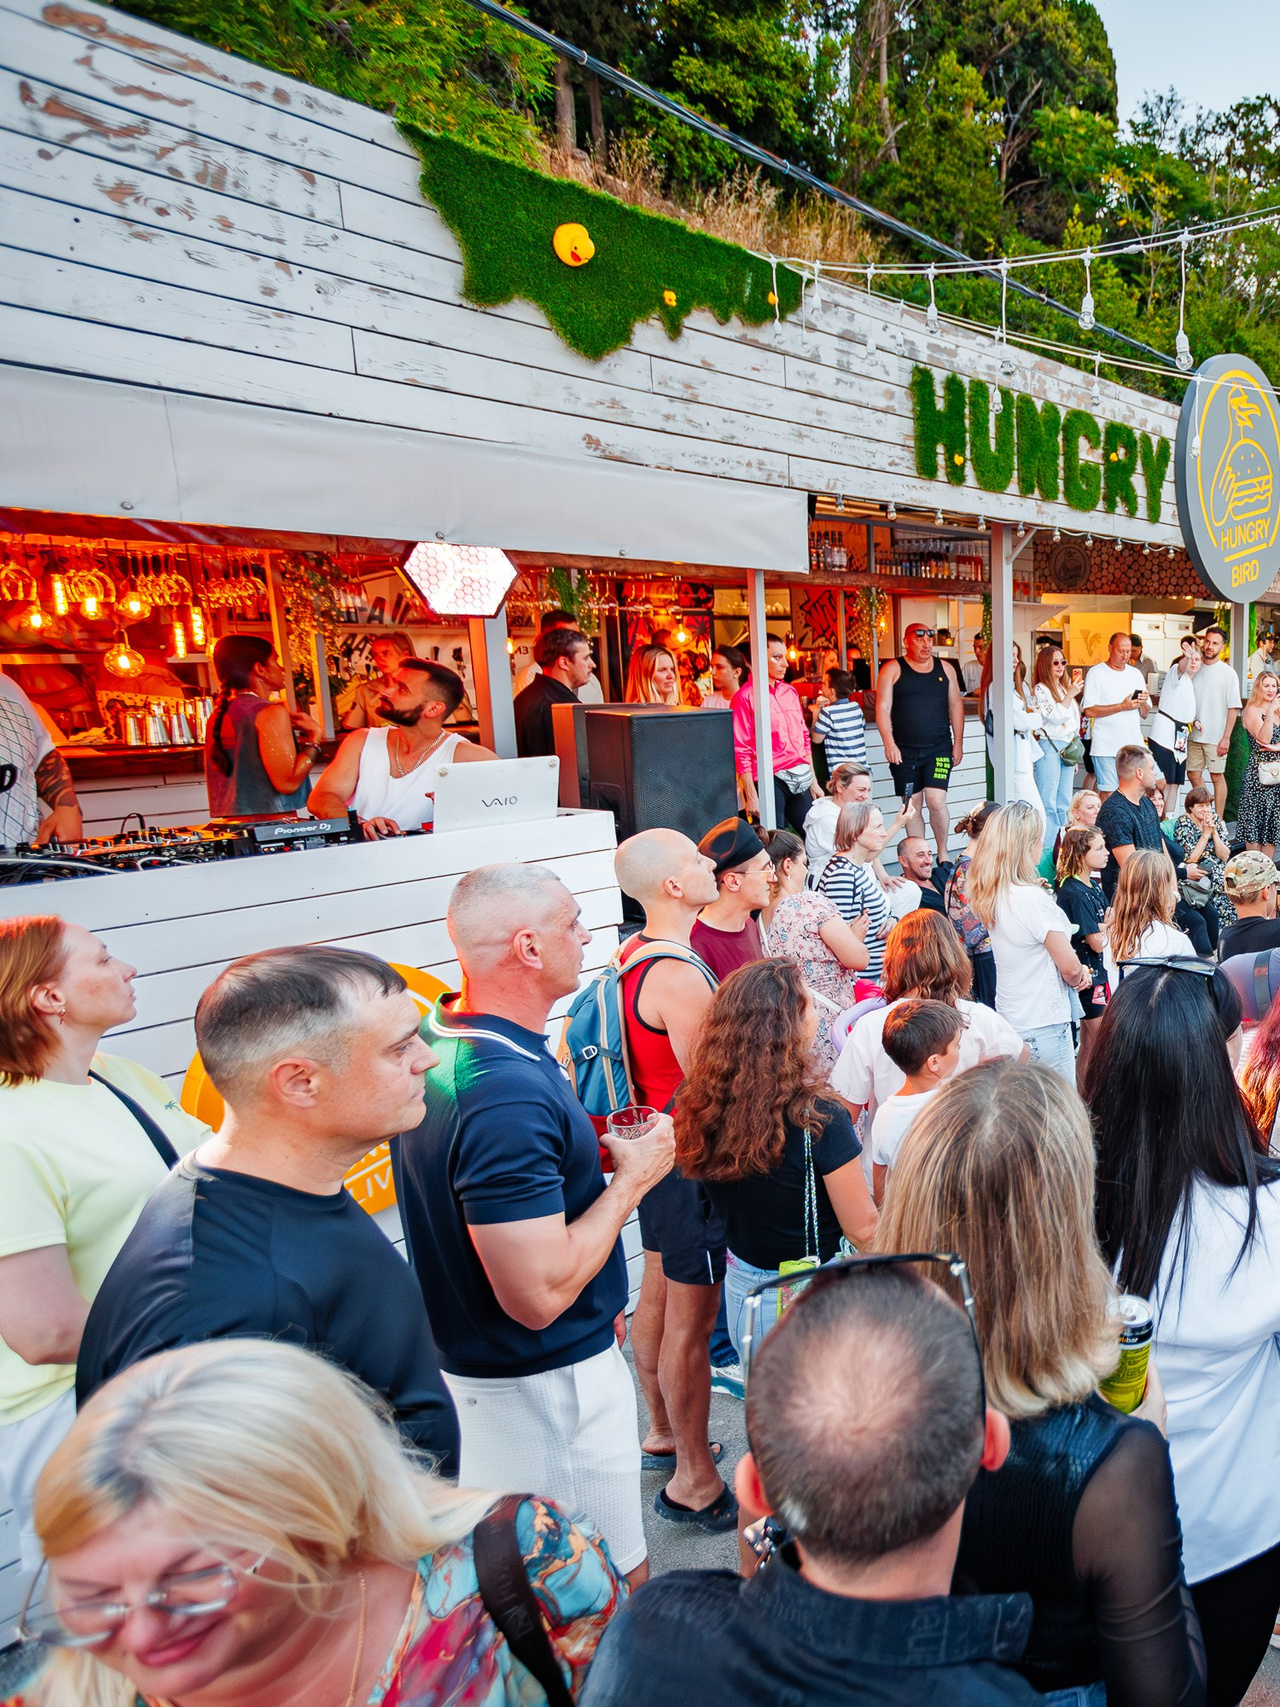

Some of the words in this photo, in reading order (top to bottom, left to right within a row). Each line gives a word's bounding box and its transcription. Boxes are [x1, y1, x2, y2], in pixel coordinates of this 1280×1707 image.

[910, 363, 1171, 524] HUNGRY
[1220, 517, 1271, 551] HUNGRY
[1231, 558, 1260, 588] BIRD
[481, 796, 518, 808] VAIO
[274, 825, 318, 835] Pioneer
